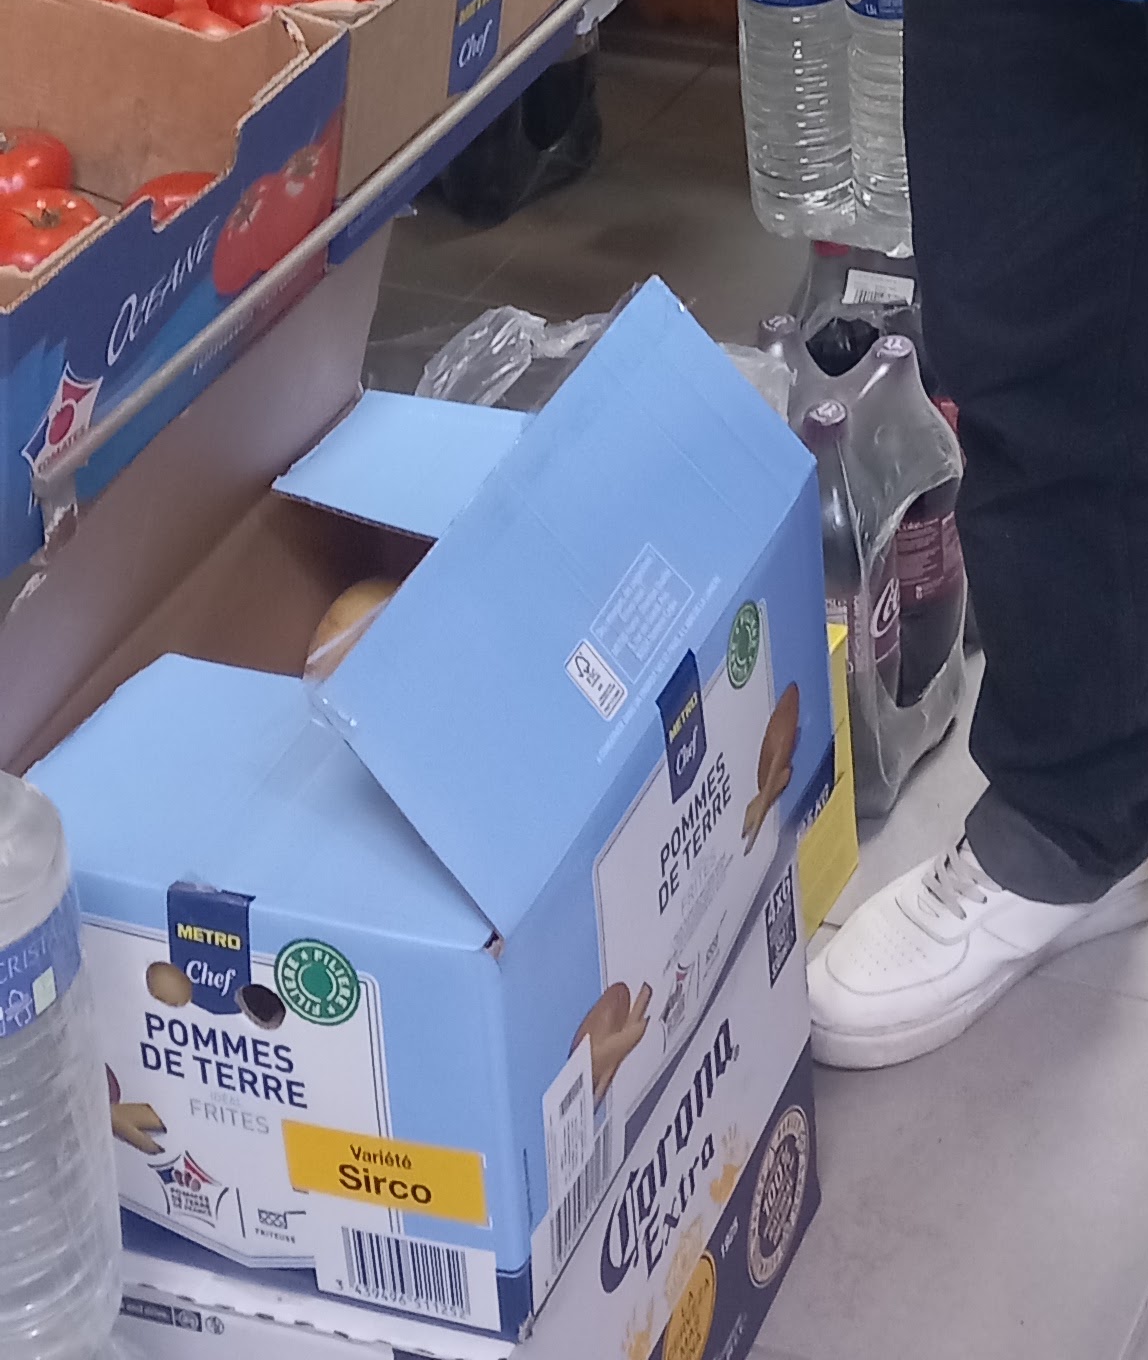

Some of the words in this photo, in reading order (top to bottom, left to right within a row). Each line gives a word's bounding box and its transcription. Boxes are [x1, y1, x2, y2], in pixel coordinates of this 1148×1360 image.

[457, 21, 493, 69] Chef
[667, 690, 699, 742] METRO
[659, 751, 727, 879] POMMES
[657, 868, 681, 915] DE
[683, 783, 732, 872] TERRE
[176, 923, 242, 951] METRO
[186, 959, 238, 996] Chef
[144, 1011, 296, 1076] POMMES
[139, 1042, 184, 1079] DE
[192, 1053, 309, 1111] TERRE
[190, 1098, 271, 1136] FRITES
[348, 1144, 413, 1171] Variété
[600, 1017, 734, 1294] Corona
[338, 1162, 433, 1206] Sirco
[644, 1132, 716, 1280] Extra
